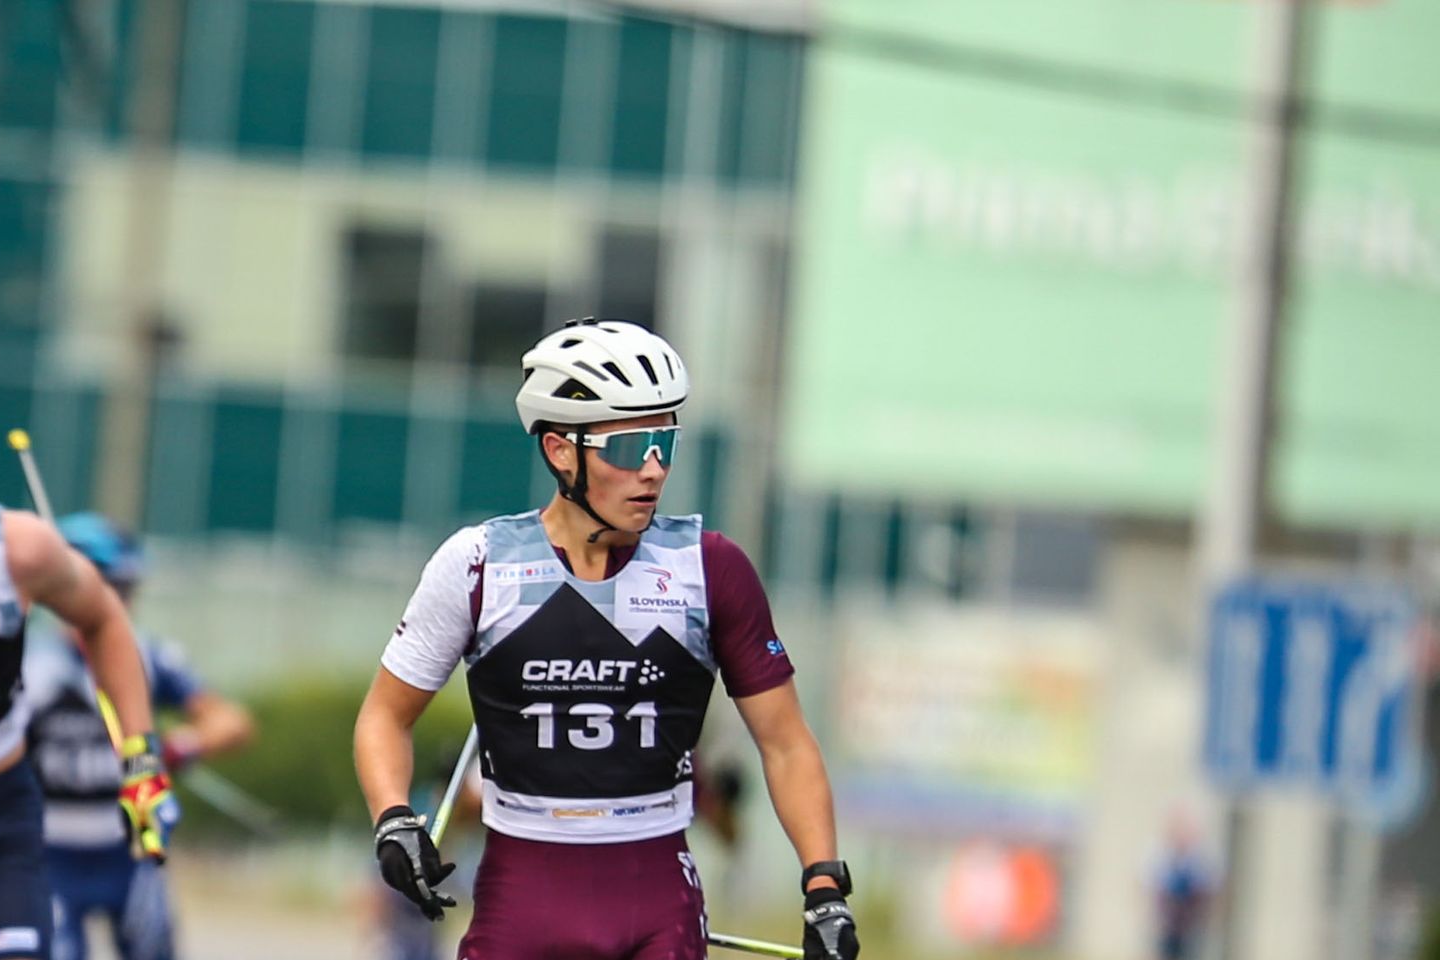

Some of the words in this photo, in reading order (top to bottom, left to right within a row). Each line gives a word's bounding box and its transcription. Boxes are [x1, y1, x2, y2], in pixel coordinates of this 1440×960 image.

[522, 659, 637, 682] CRAFT
[522, 684, 570, 692] FUNCTIONAL
[572, 684, 626, 692] SPORTSWEAR
[519, 701, 658, 750] 131
